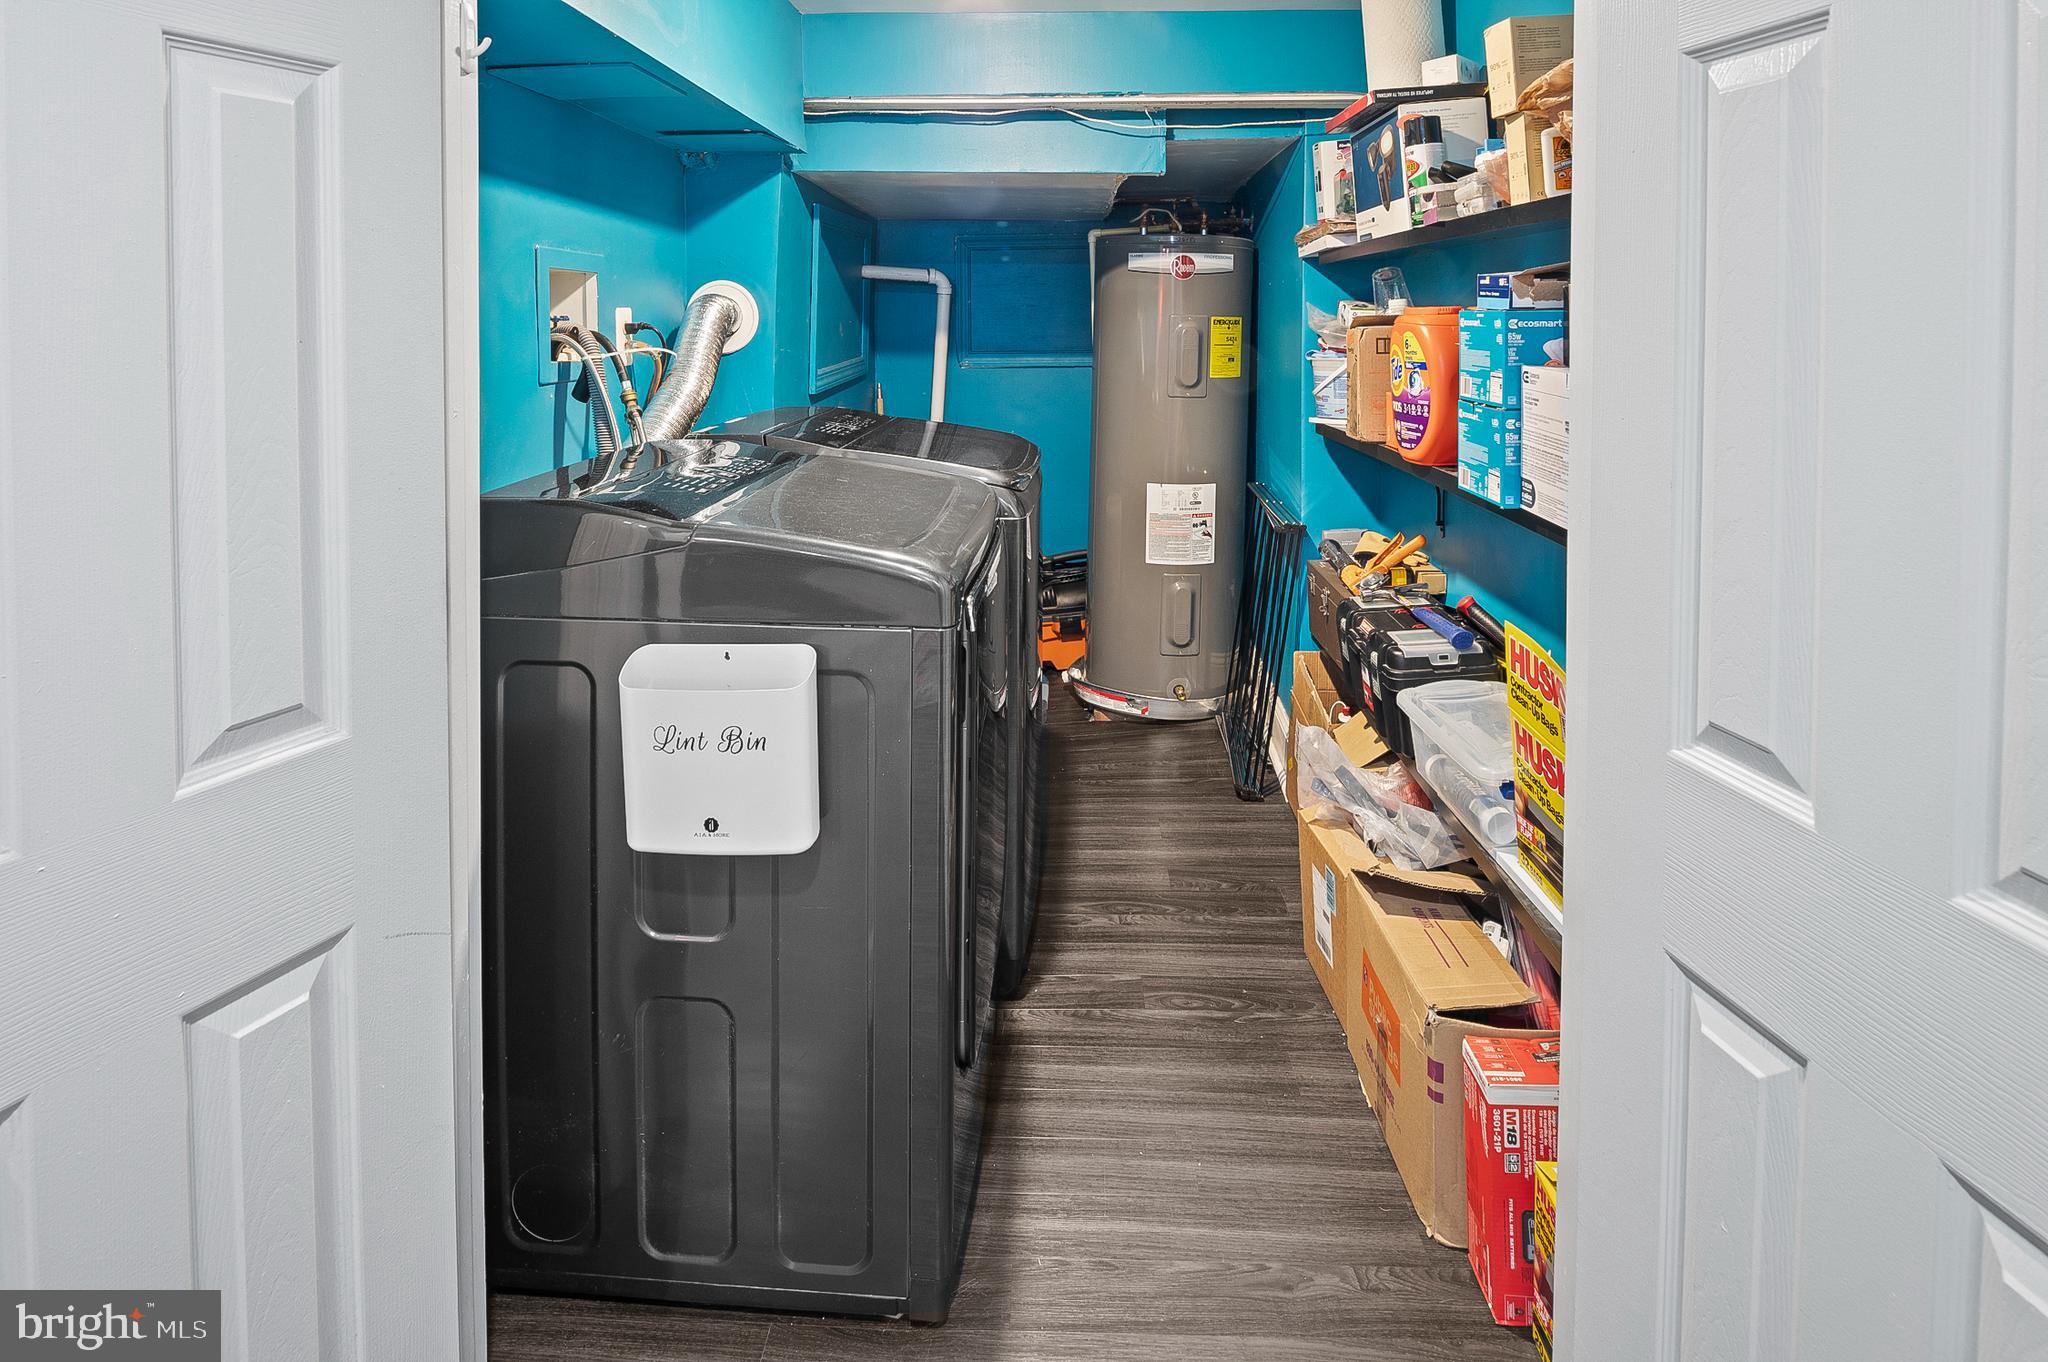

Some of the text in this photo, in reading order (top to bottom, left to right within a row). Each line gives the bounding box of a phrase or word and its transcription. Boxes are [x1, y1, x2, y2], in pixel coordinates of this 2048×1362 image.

[1173, 256, 1195, 276] Rheem
[1517, 319, 1563, 328] ecosmart
[1391, 356, 1403, 383] Tide
[1511, 676, 1543, 710] Contractor
[1511, 688, 1558, 736] Clean-Up Bags
[653, 724, 767, 754] Lint Bin
[1516, 757, 1547, 797] Contractor
[1493, 1109, 1501, 1153] 3601-21P
[1507, 1112, 1517, 1145] M18
